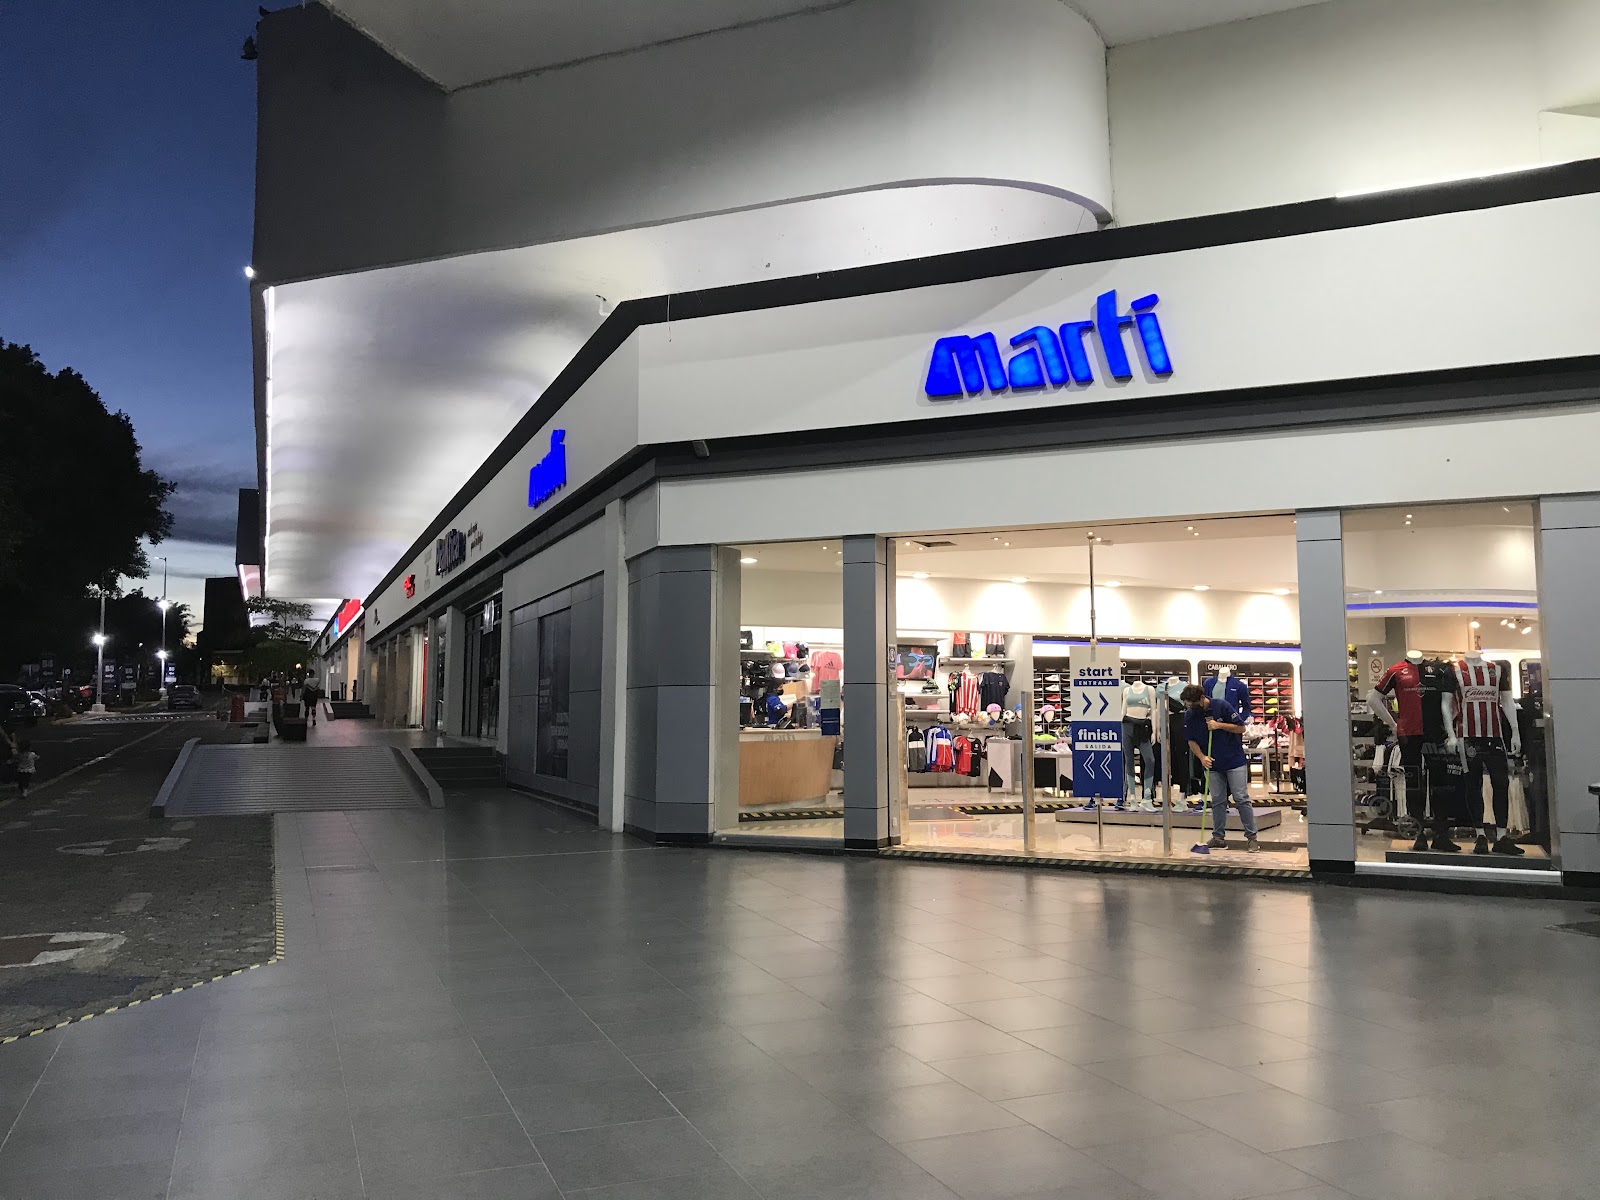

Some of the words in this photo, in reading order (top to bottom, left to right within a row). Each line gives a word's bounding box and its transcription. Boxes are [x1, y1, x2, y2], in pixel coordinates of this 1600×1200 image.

[925, 289, 1173, 397] marti
[1079, 666, 1113, 677] start
[1078, 728, 1118, 741] finish
